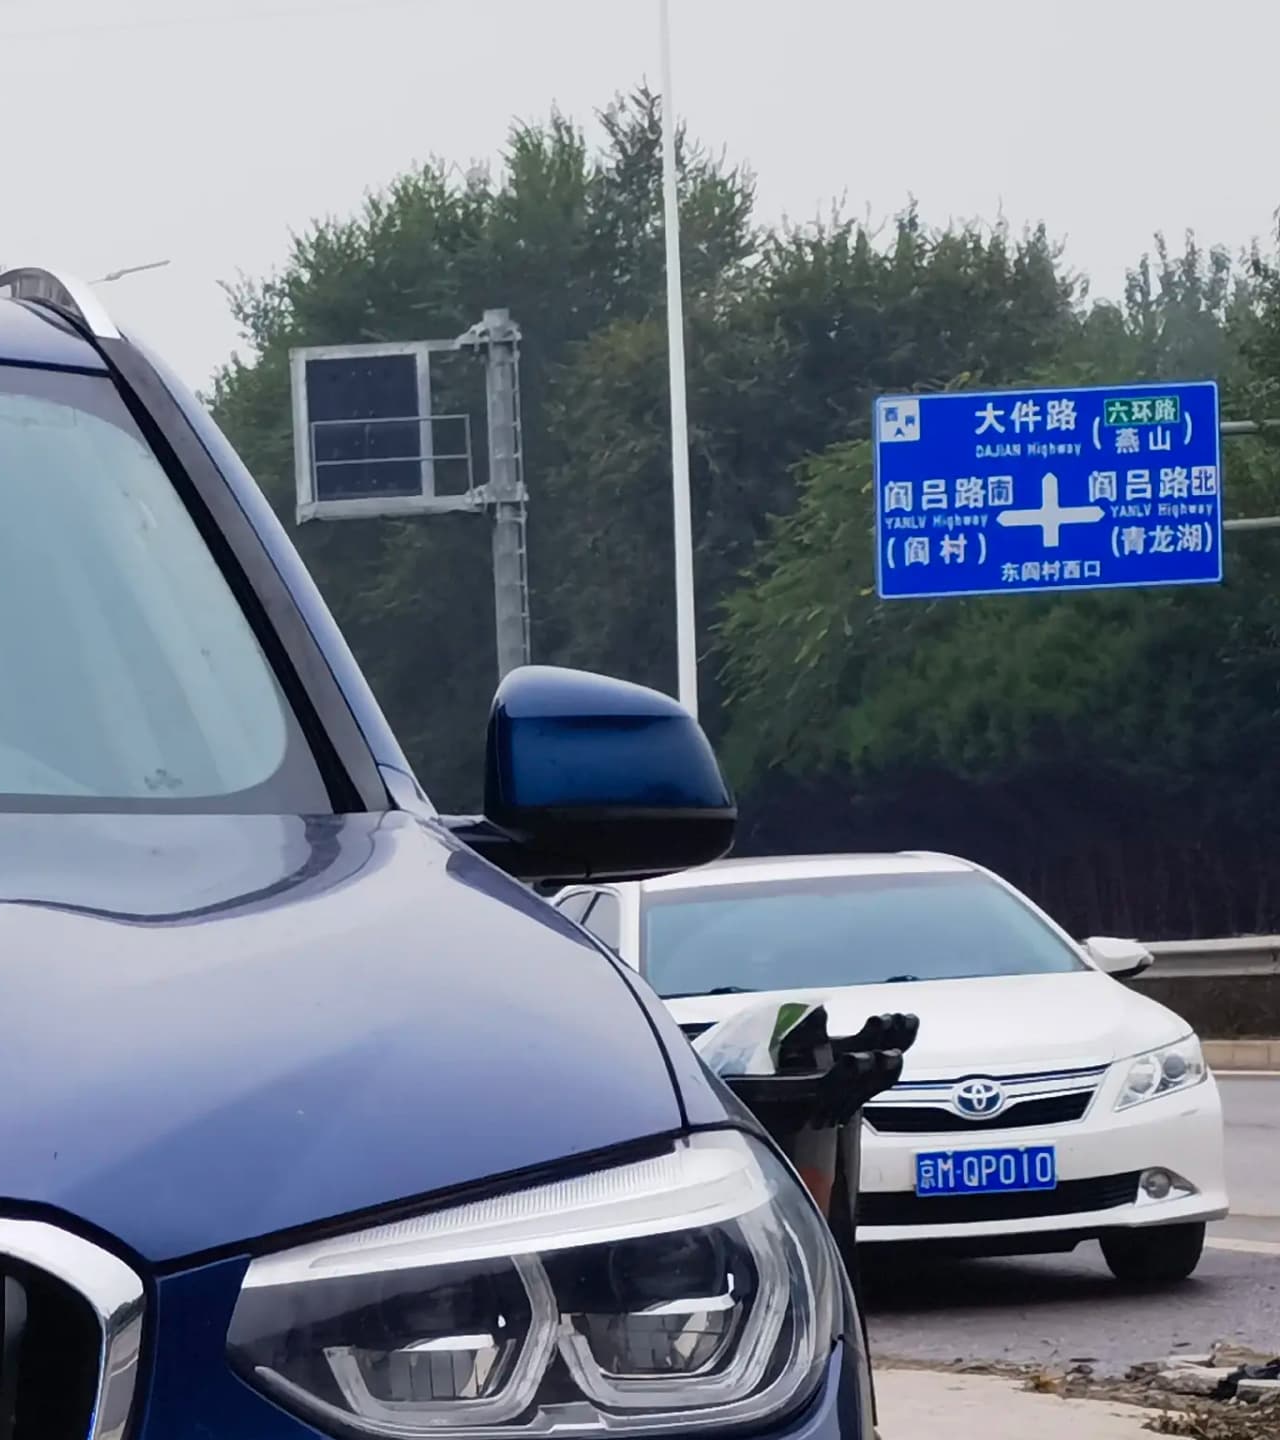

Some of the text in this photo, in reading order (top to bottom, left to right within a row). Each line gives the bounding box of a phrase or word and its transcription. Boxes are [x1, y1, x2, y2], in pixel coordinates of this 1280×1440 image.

[974, 398, 1078, 435] 大件路
[1107, 398, 1177, 423] 六环路
[1110, 502, 1213, 519] YANLV Highway
